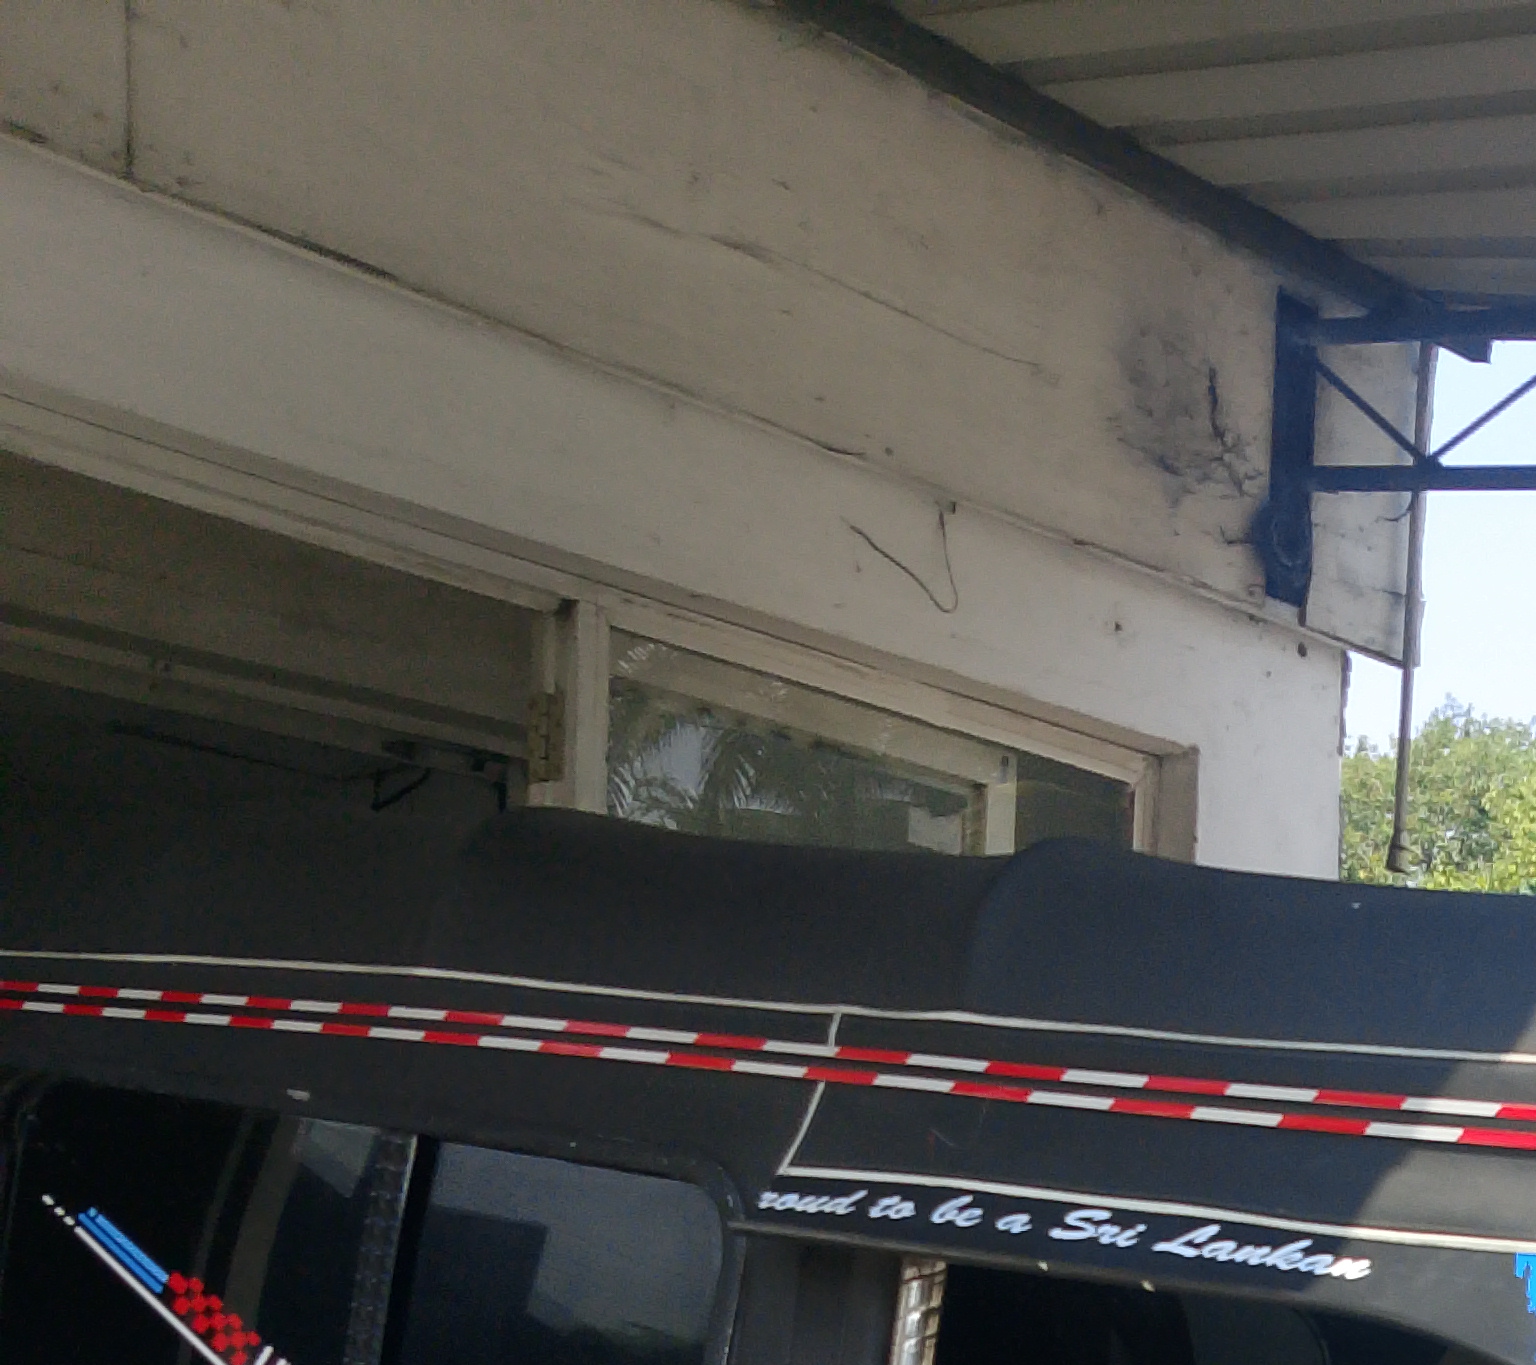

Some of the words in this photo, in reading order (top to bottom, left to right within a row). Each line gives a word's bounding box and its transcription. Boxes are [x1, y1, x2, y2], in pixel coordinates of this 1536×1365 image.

[868, 1195, 917, 1220] to
[930, 1195, 984, 1228] be
[994, 1212, 1033, 1234] a
[1047, 1208, 1148, 1249] Sri
[1151, 1223, 1373, 1281] Lankan
